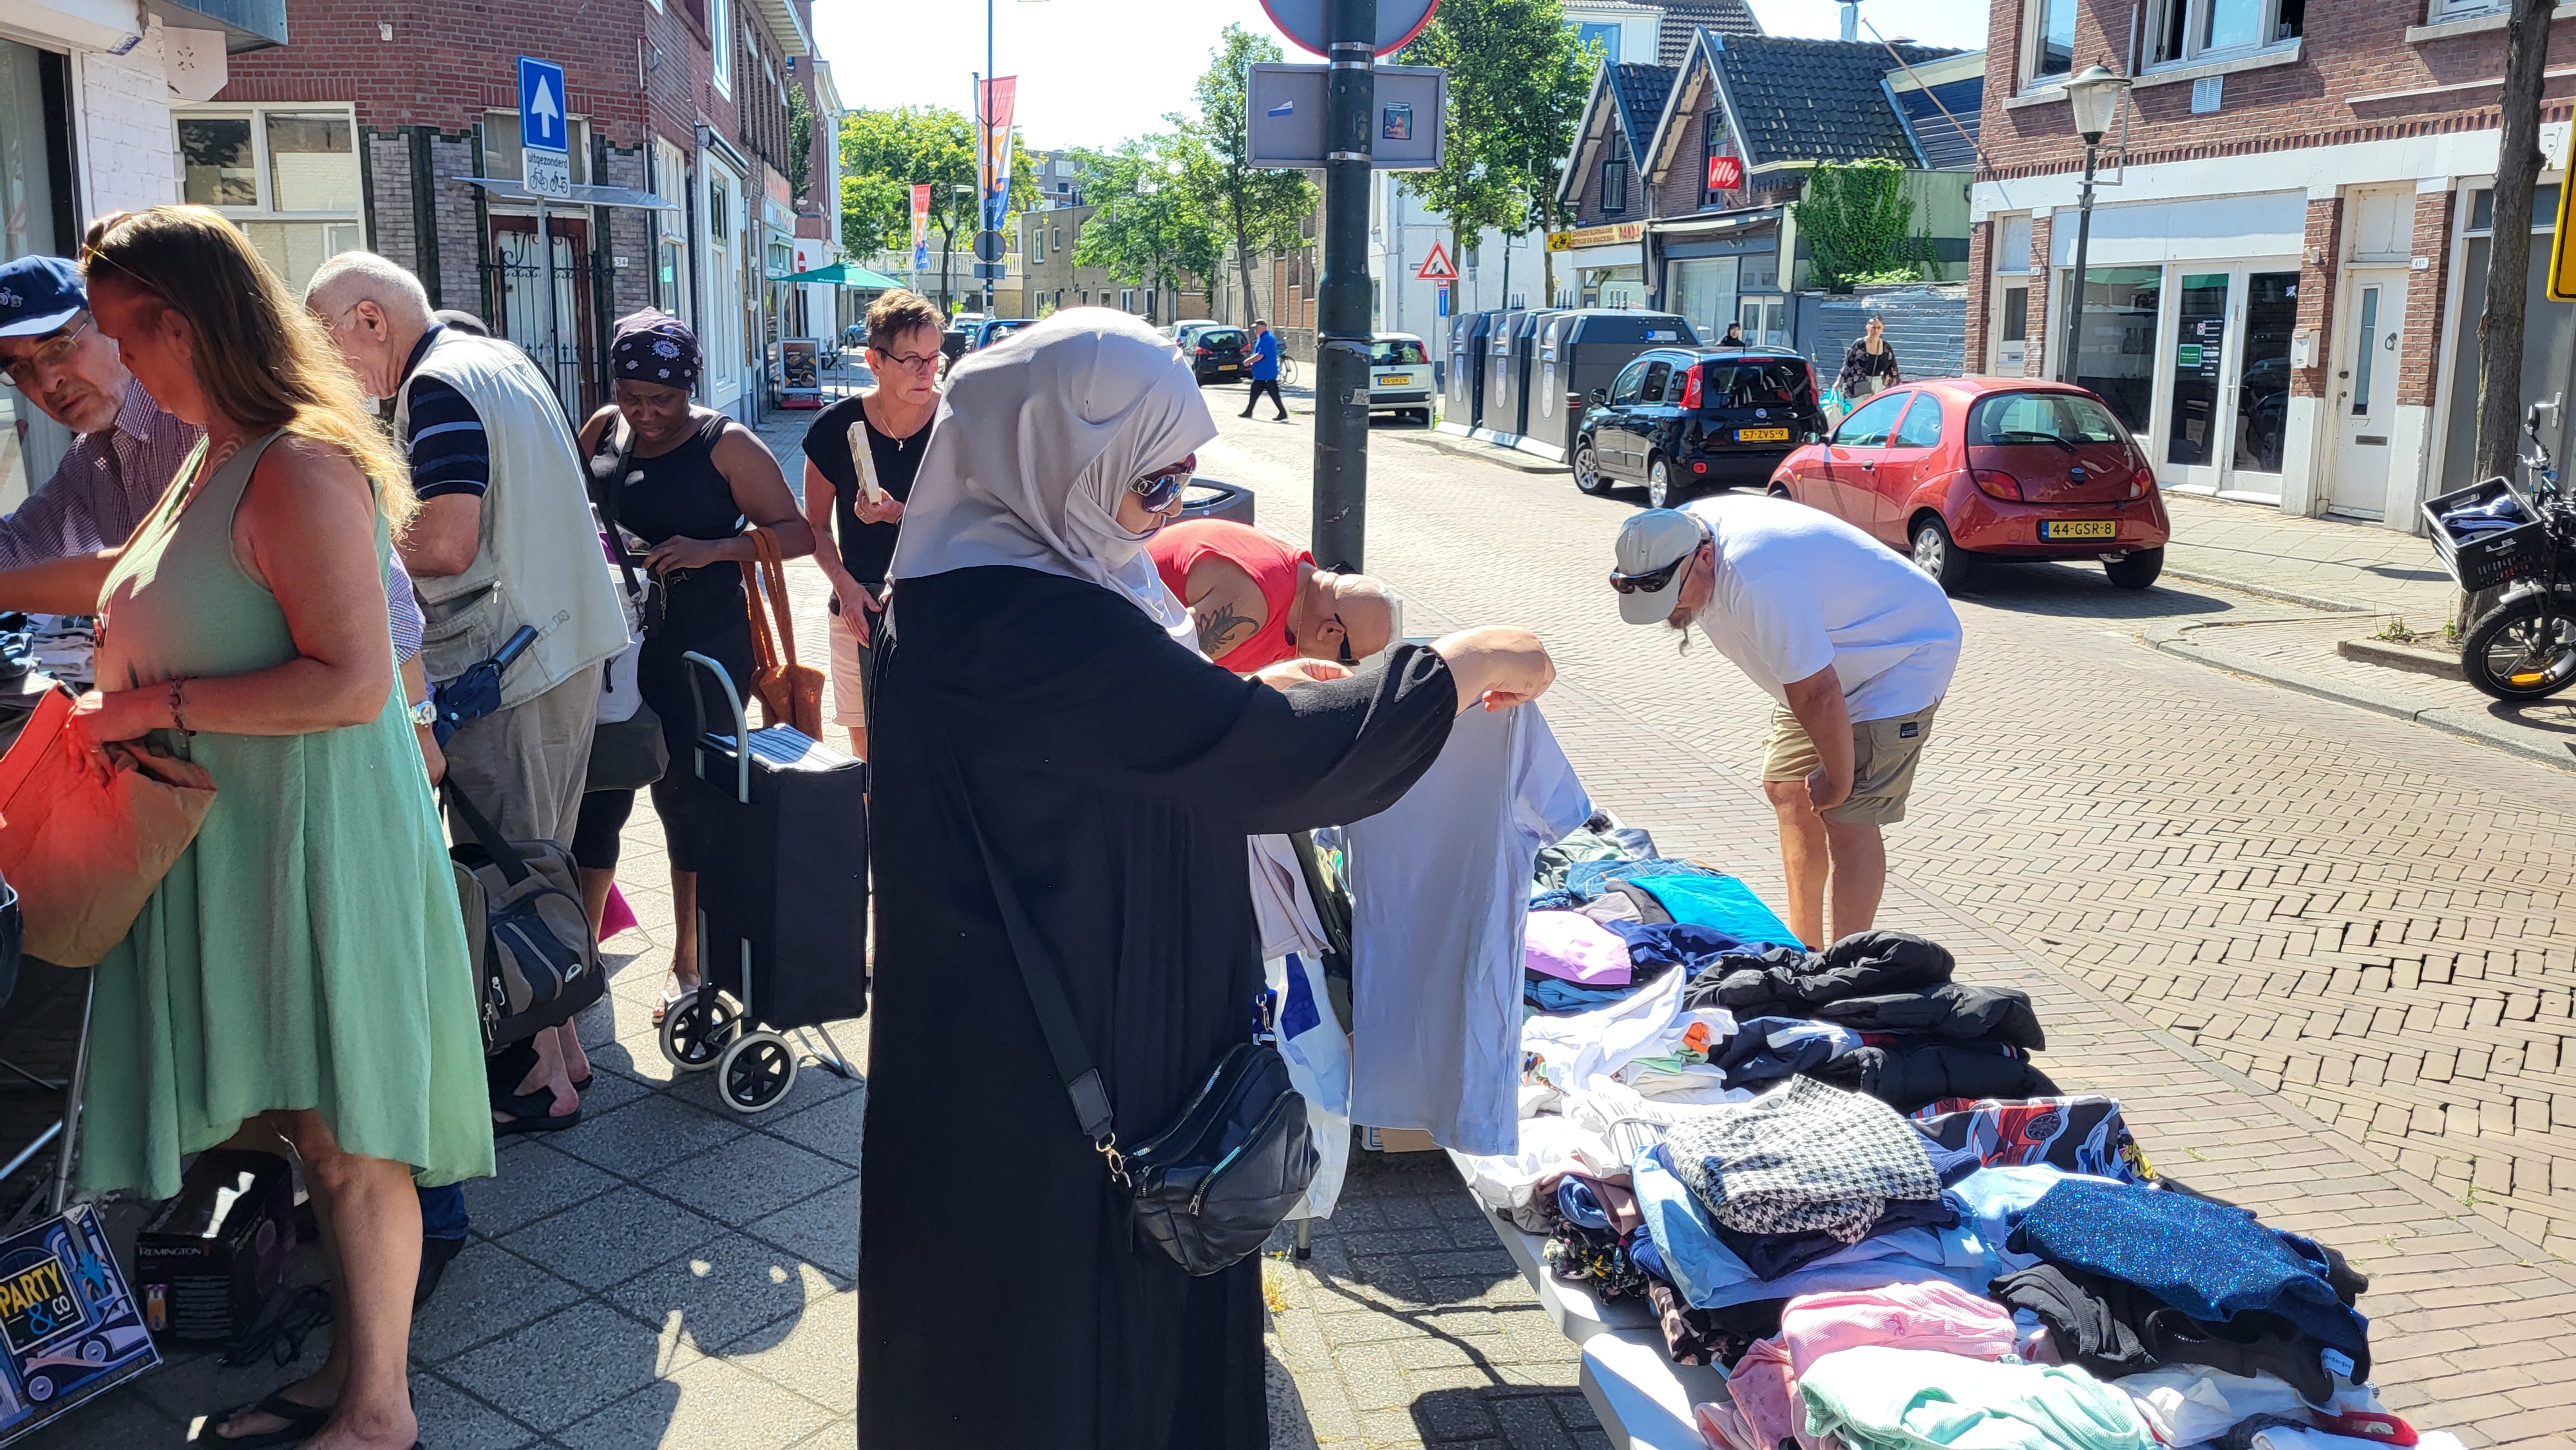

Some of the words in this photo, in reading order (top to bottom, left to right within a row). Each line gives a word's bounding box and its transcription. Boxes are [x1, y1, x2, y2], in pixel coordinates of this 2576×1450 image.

[528, 153, 568, 169] uitgezonderd
[1712, 161, 1739, 187] illy
[1618, 224, 1640, 241] PANDA
[1743, 429, 1784, 439] 57-ZVS-9
[2052, 523, 2112, 536] 44-GSR-8
[139, 1247, 202, 1256] REMINGTON
[0, 1262, 62, 1318] PARTY
[28, 1302, 58, 1335] &
[52, 1295, 70, 1315] CO
